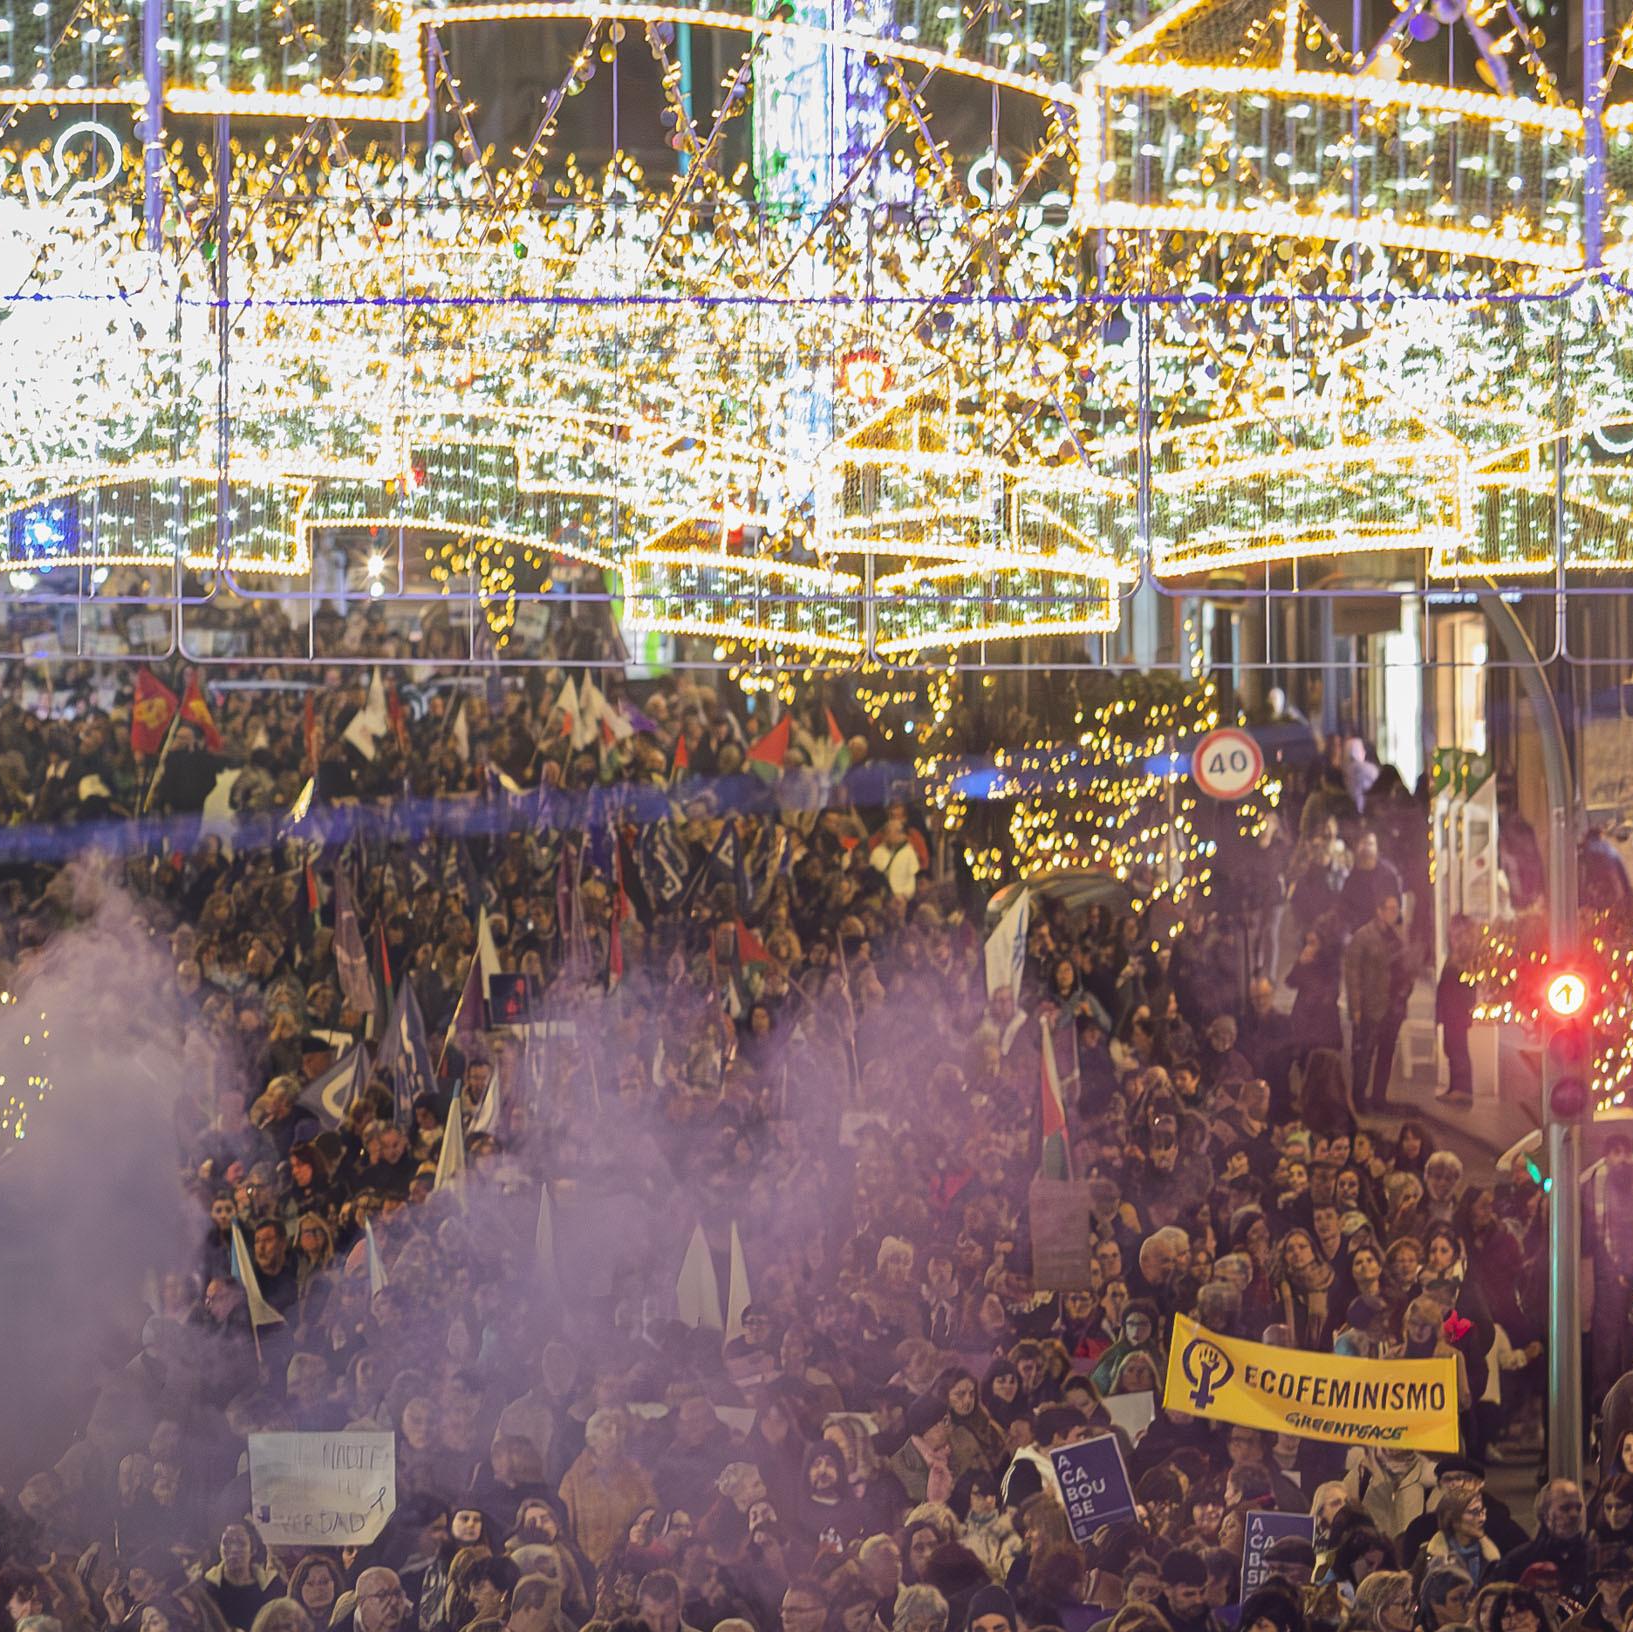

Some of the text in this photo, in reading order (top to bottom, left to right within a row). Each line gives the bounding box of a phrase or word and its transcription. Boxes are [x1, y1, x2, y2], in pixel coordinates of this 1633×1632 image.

[1209, 750, 1248, 775] 40
[1245, 1365, 1446, 1411] ECOFEMINISMO
[1285, 1412, 1408, 1441] GREENPEACE
[1066, 1478, 1106, 1501] BOU
